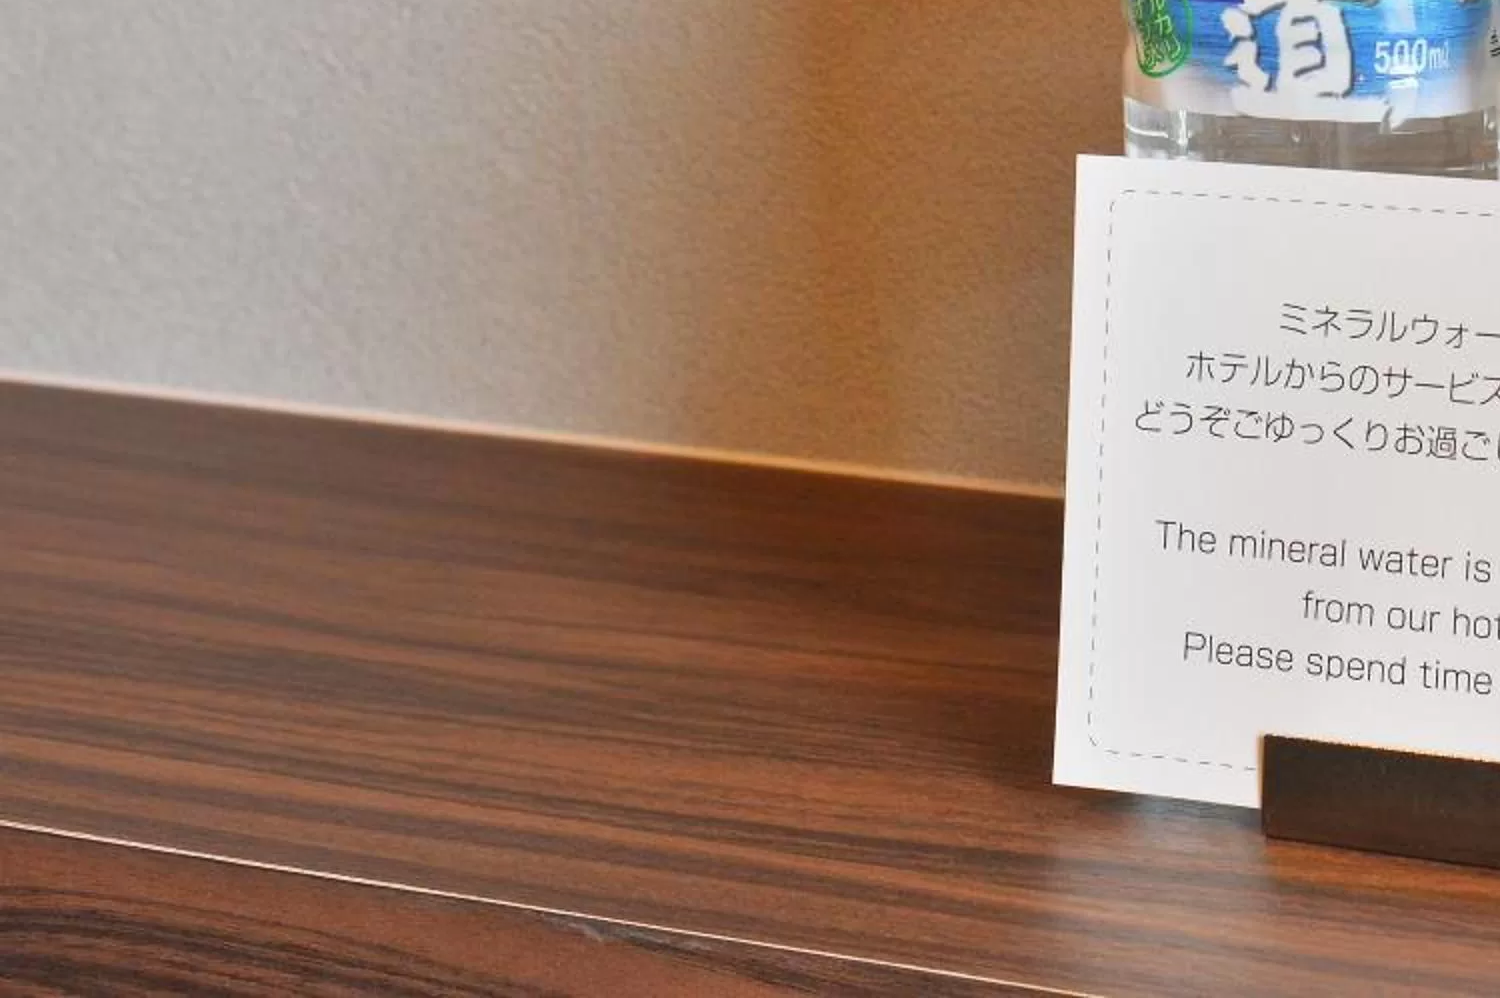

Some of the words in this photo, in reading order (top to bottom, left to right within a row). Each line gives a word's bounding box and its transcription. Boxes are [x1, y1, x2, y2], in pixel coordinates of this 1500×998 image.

[1155, 519, 1217, 555] The
[1229, 529, 1347, 568] mineral
[1358, 547, 1454, 580] water
[1465, 550, 1491, 584] is
[1301, 589, 1375, 627] from
[1387, 606, 1441, 634] our
[1183, 630, 1294, 673] Please
[1305, 647, 1407, 686] spend
[1418, 659, 1493, 696] time
